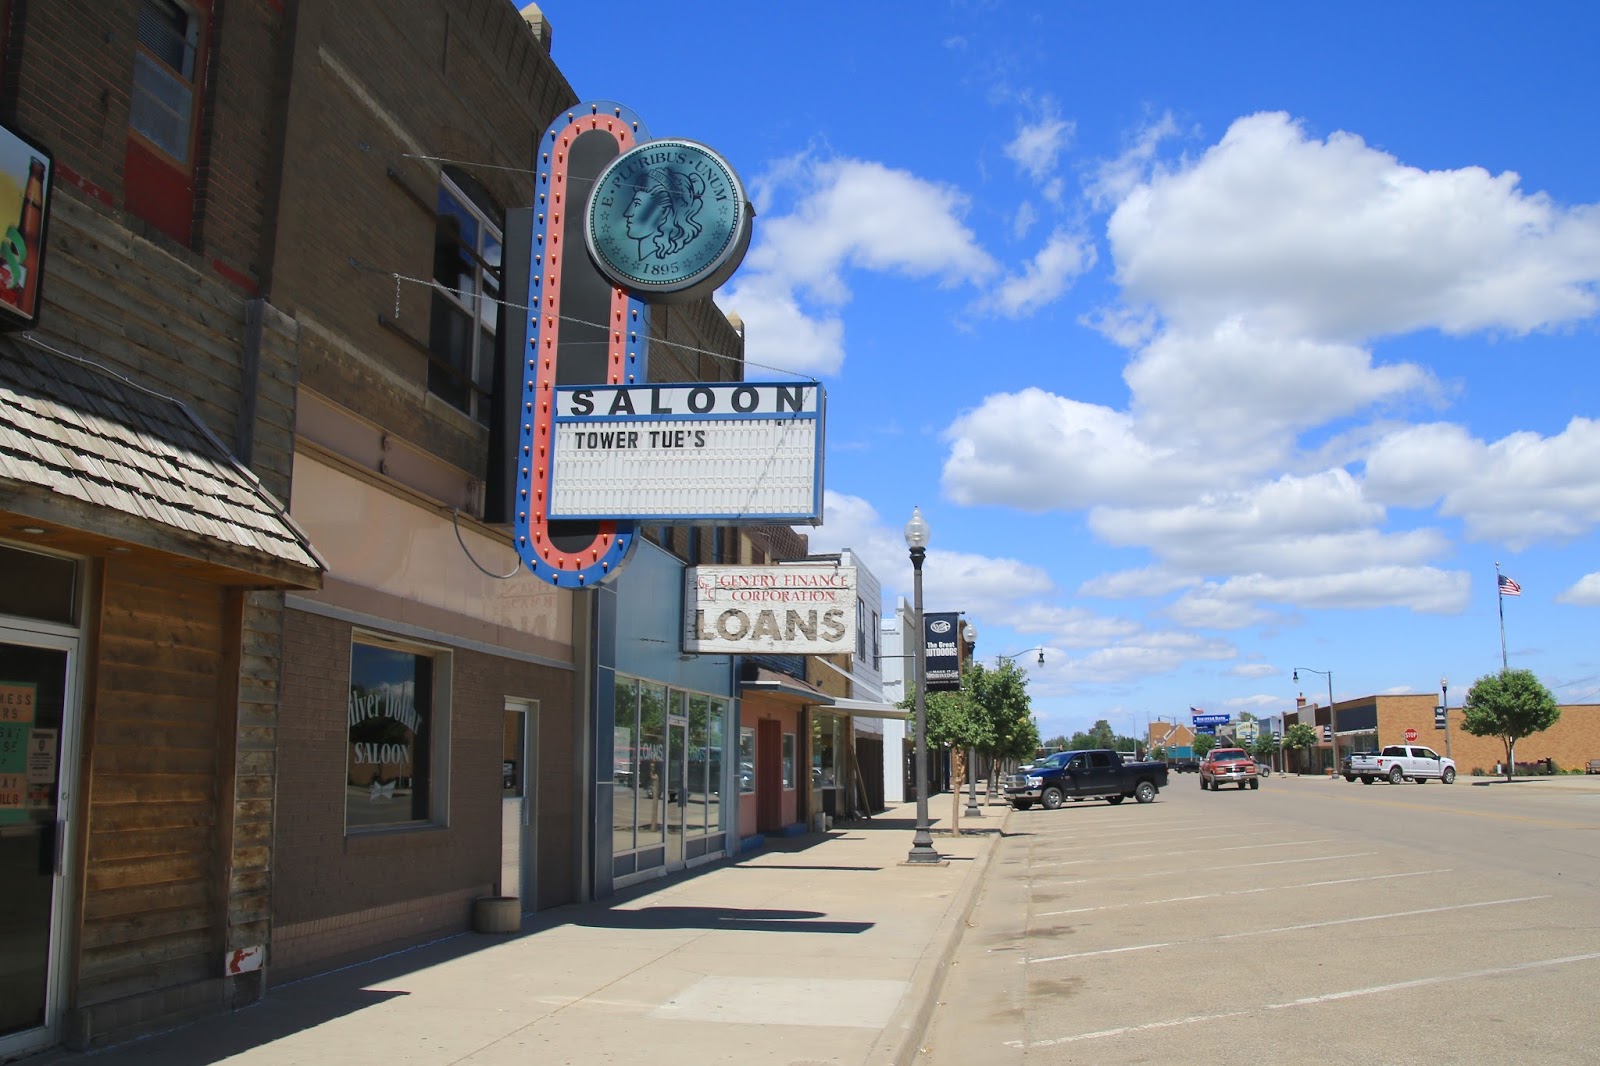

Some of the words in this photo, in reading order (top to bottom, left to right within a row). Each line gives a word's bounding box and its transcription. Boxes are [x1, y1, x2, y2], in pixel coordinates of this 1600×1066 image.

[601, 197, 614, 208] E
[612, 152, 687, 189] PLURIBUS
[695, 160, 728, 202] UNUM
[643, 261, 680, 276] 1895
[570, 386, 803, 416] SALOON
[575, 431, 638, 450] TOWER
[650, 430, 706, 449] TUE'S
[720, 574, 778, 587] GENTRY
[785, 574, 848, 587] FINANCE
[732, 590, 836, 602] CORPORATION
[695, 608, 846, 642] LOANS
[350, 690, 381, 726] ilver
[354, 742, 411, 764] SALOON
